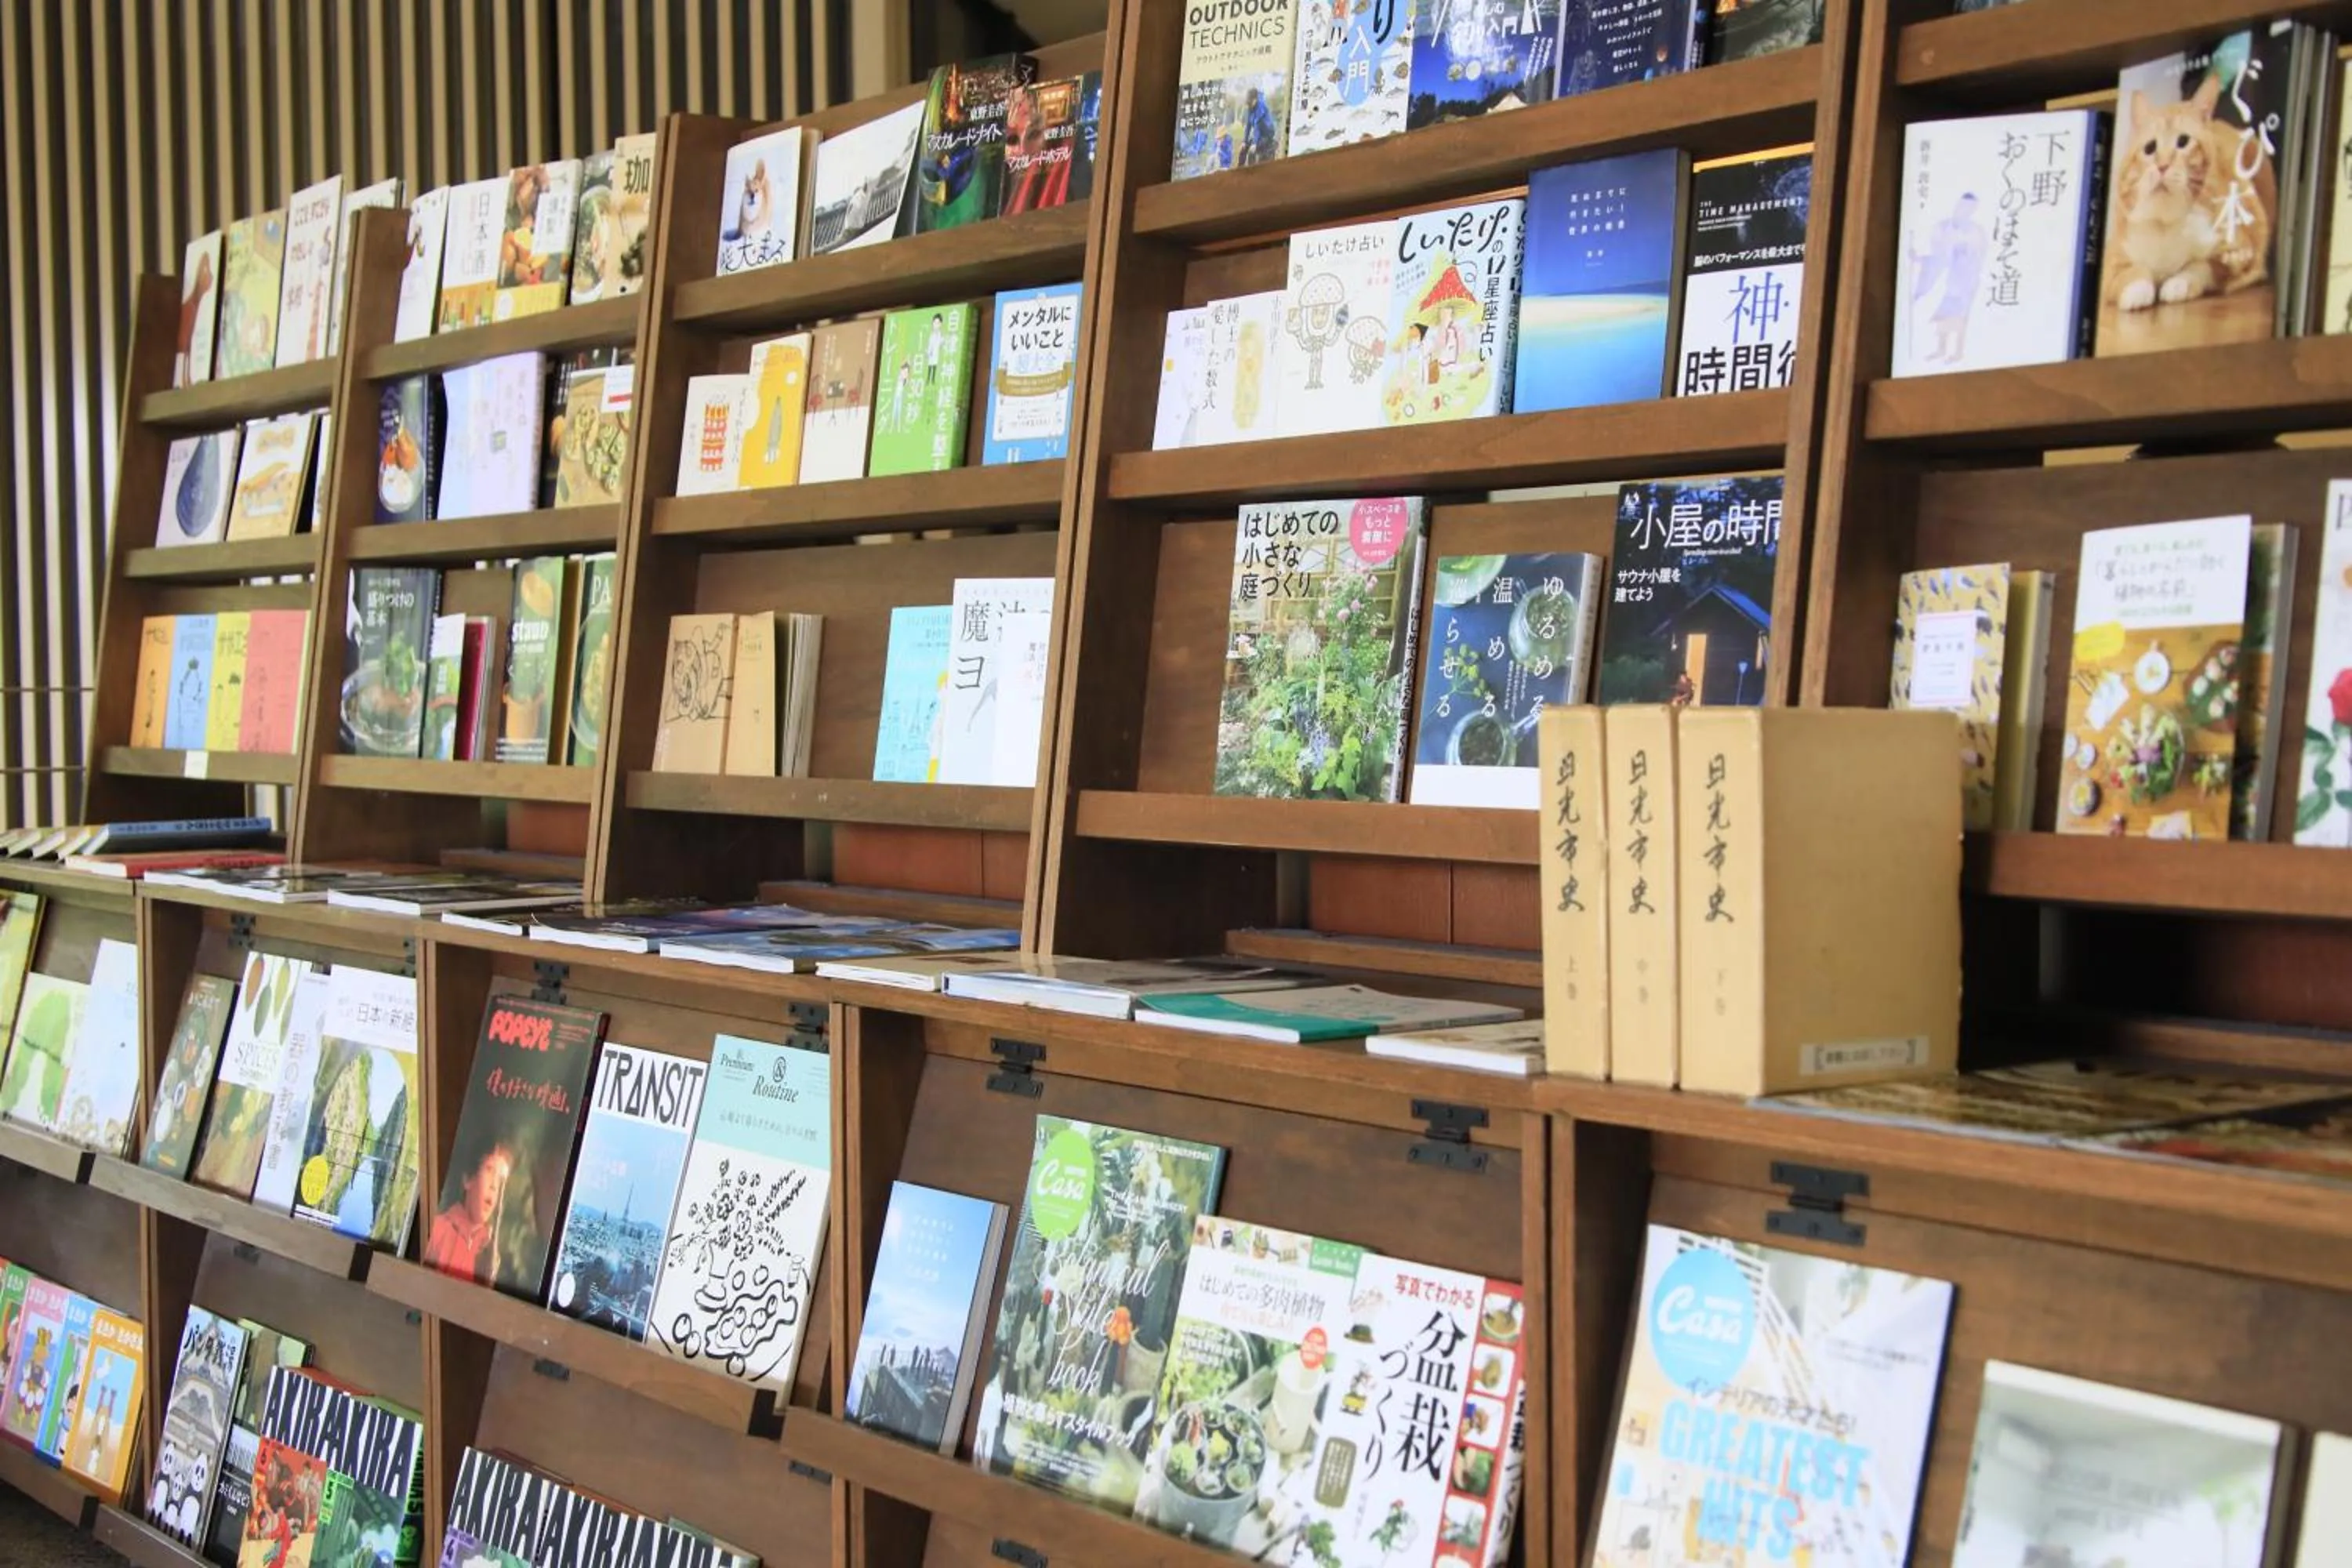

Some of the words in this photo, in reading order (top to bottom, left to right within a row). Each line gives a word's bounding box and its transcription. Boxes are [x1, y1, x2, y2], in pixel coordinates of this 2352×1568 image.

[1189, 16, 1285, 49] TECHNICS
[2031, 130, 2071, 207] 下野
[1986, 132, 2029, 307] おくのほそ道
[1009, 307, 1072, 328] メンタルに
[1011, 331, 1064, 350] いいこと
[1243, 510, 1339, 538] はじめての
[1242, 543, 1301, 569] 小さな
[1617, 567, 1681, 584] サウナ小屋を
[1240, 572, 1312, 601] 庭づくり
[1556, 751, 1584, 913] 日光市史
[1626, 749, 1655, 916] 日光市史
[1702, 753, 1734, 924] 日光市史
[488, 1009, 553, 1052] POPEYE
[598, 1051, 703, 1127] TRANSIT
[752, 1075, 799, 1103] Routine
[1394, 1273, 1475, 1309] 写真でわかる
[1392, 1311, 1467, 1482] 盆栽
[1658, 1399, 1872, 1507] GREATEST
